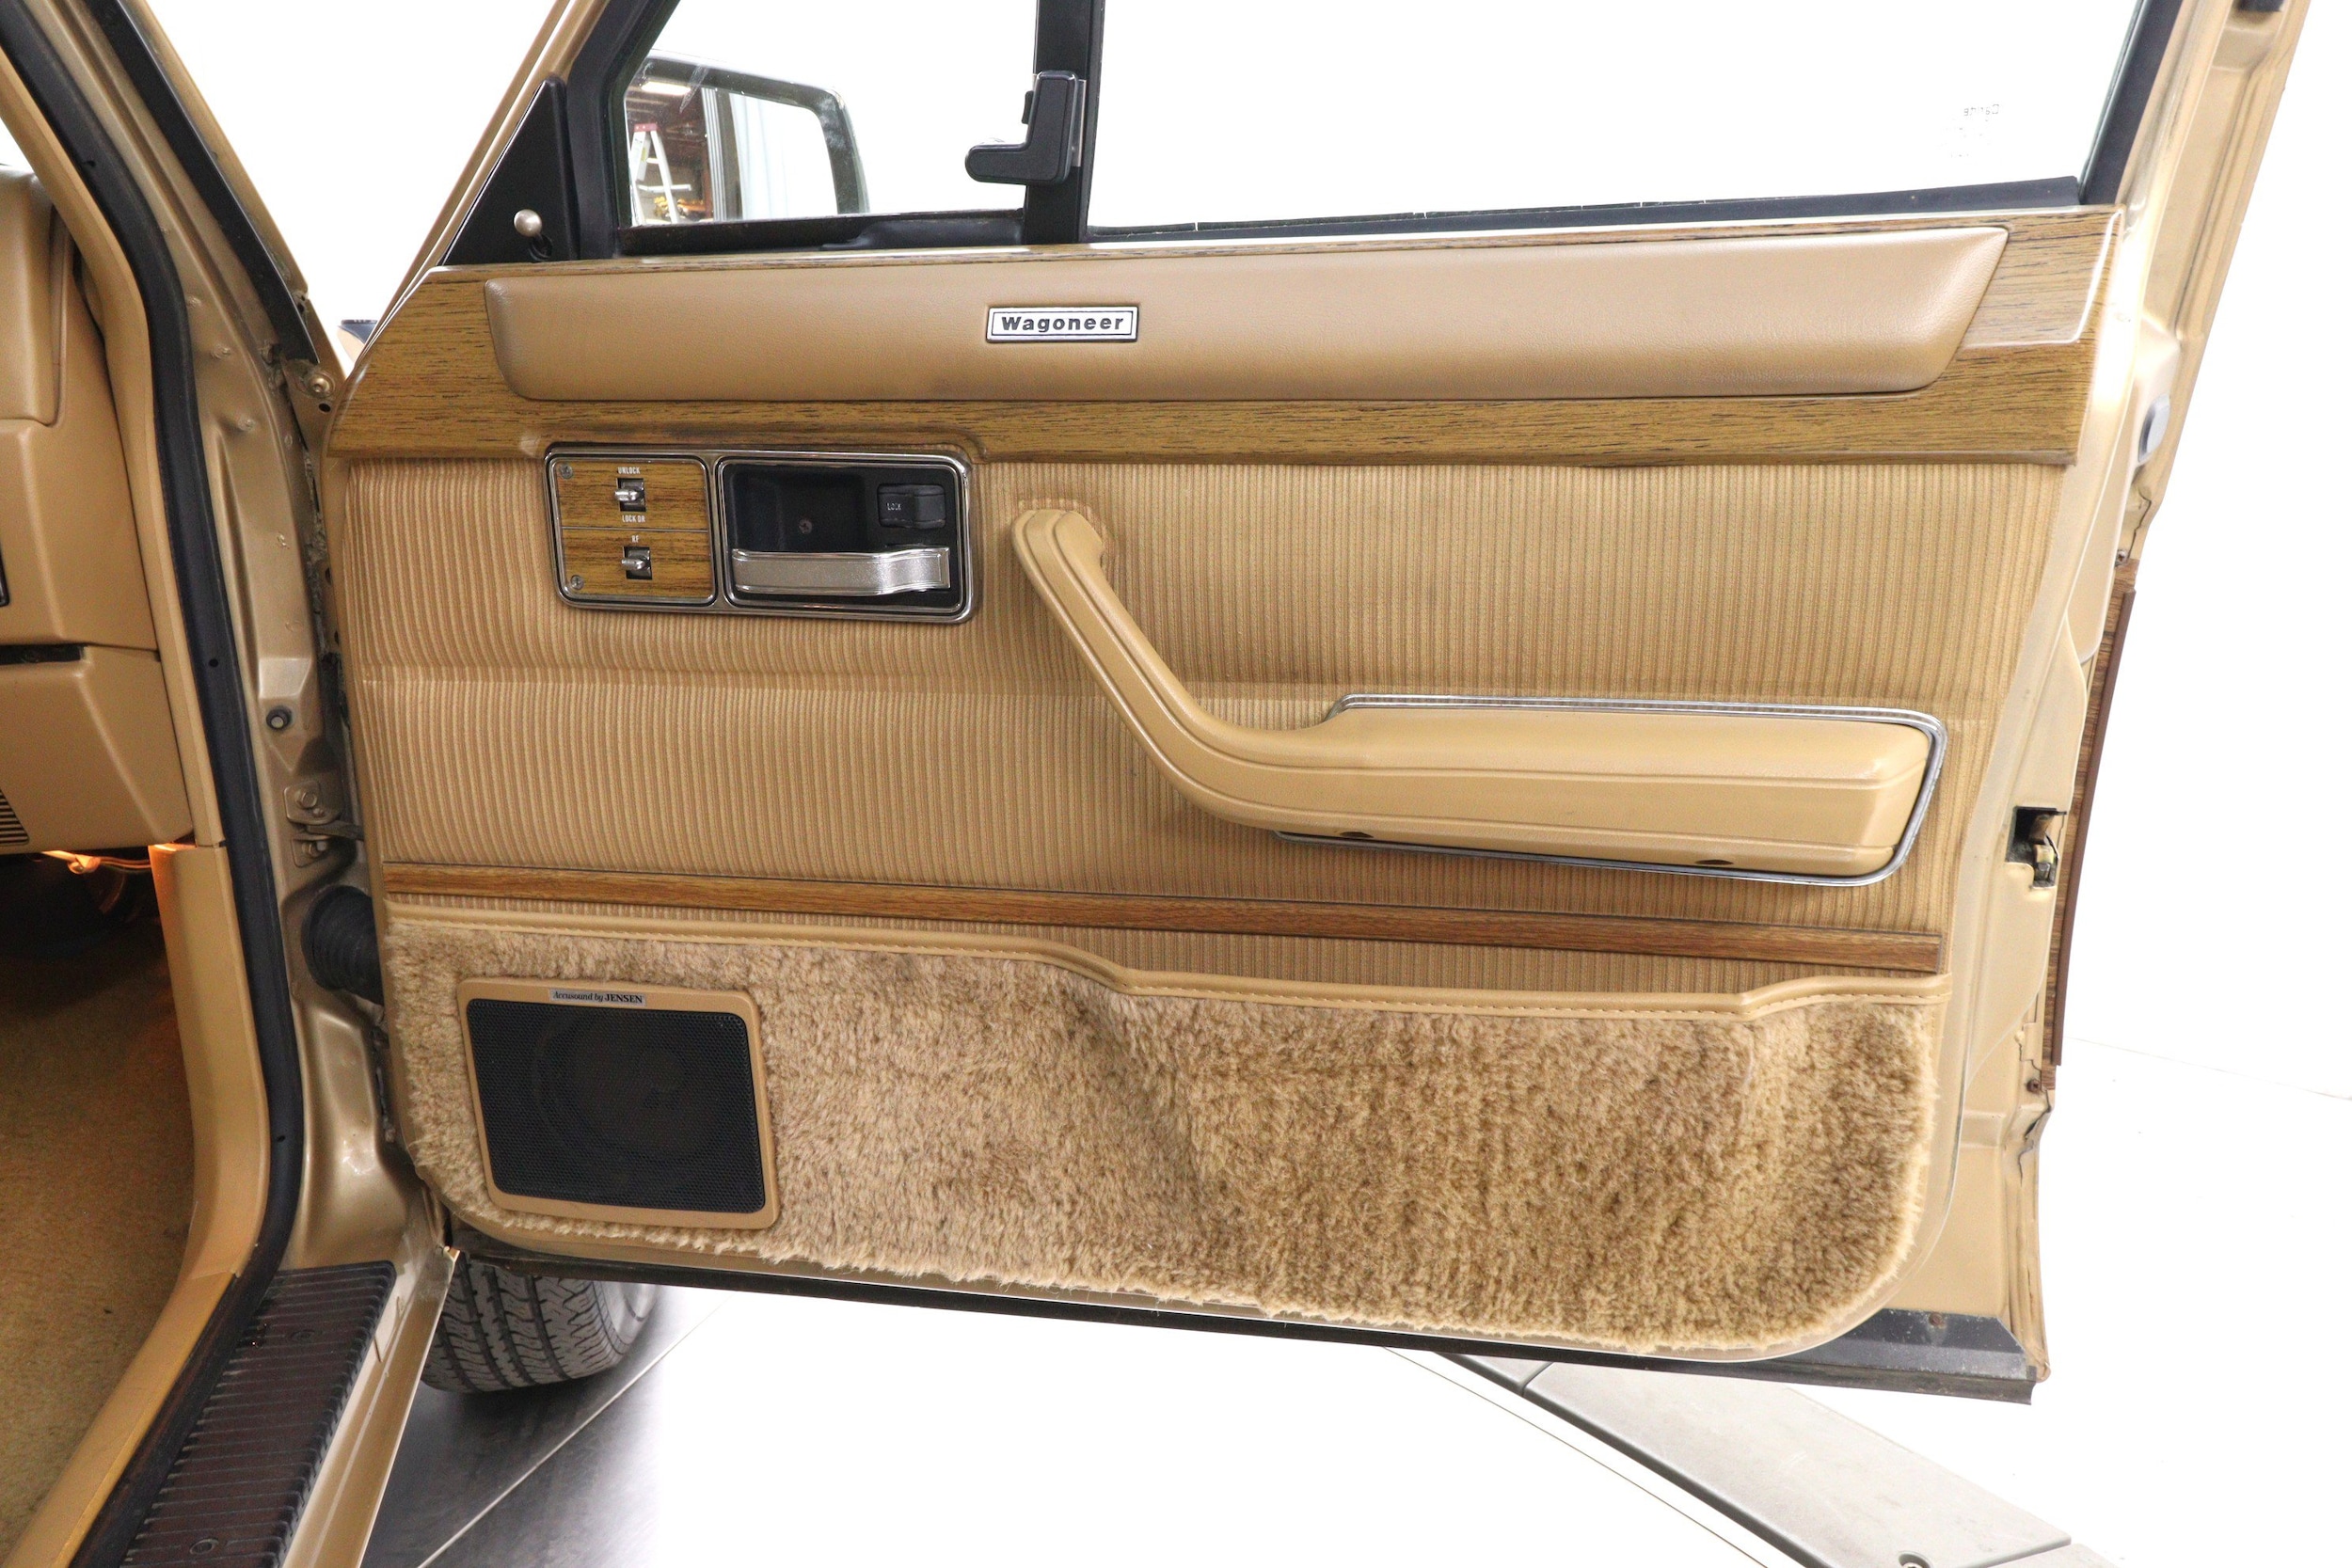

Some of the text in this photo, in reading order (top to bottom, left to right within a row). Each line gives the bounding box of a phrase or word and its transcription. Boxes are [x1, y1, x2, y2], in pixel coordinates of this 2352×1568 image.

[1001, 316, 1123, 333] Wagoneer
[617, 467, 641, 475] UNLOCK
[622, 515, 636, 523] LOCK
[553, 990, 643, 1004] Accusound by JENSEN
